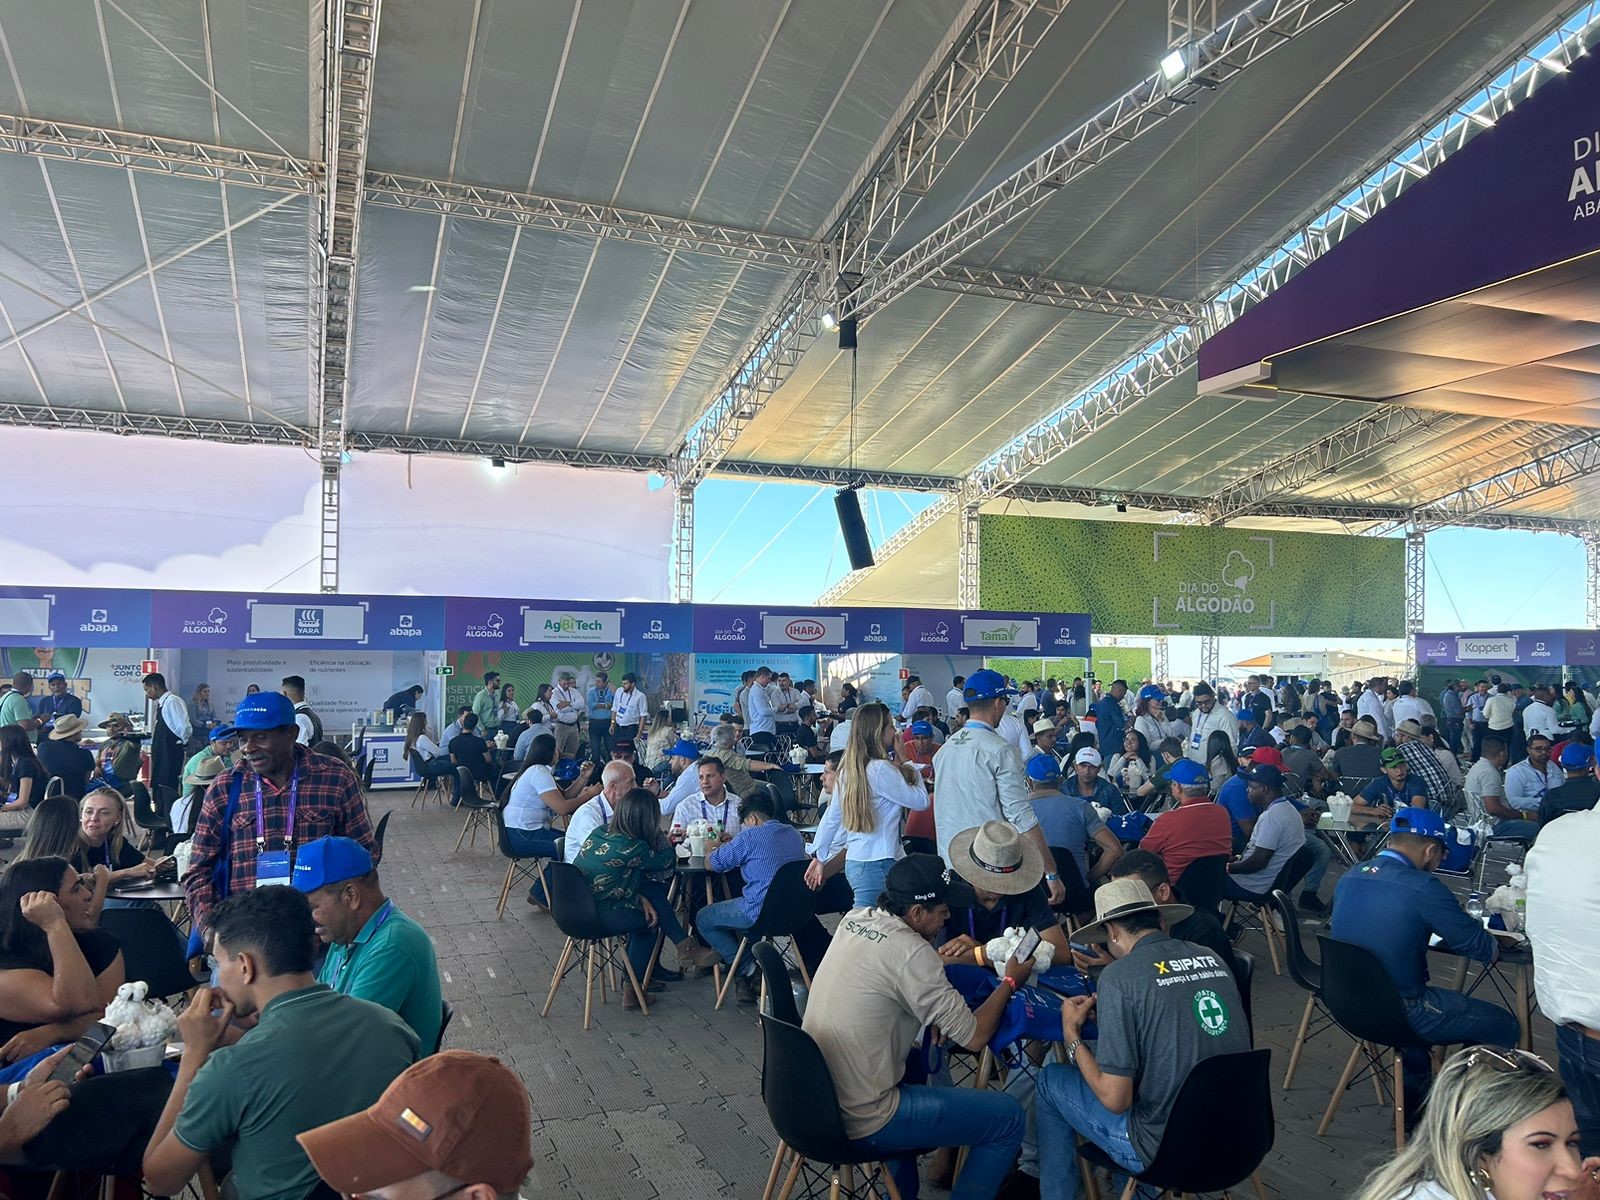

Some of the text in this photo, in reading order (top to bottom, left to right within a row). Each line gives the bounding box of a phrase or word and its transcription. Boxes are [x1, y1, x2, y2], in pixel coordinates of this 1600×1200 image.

[1567, 160, 1600, 202] A
[1178, 582, 1219, 594] DIA DO
[1175, 594, 1255, 614] ALGODÃO
[80, 622, 118, 633] abapa
[182, 624, 227, 634] ALGODÃO
[544, 618, 602, 632] AgBiTech
[389, 628, 422, 638] abapa
[465, 629, 504, 638] ALGODÃO
[642, 631, 670, 640] abapa
[789, 626, 821, 635] IHARA
[713, 633, 746, 641] ALGODÃO
[863, 634, 888, 643] abapa
[920, 635, 949, 643] ALGODÃO
[980, 631, 1008, 641] Tama
[1054, 638, 1076, 646] abapa
[1465, 642, 1509, 654] Koppert
[1153, 955, 1219, 975] X SIPATR
